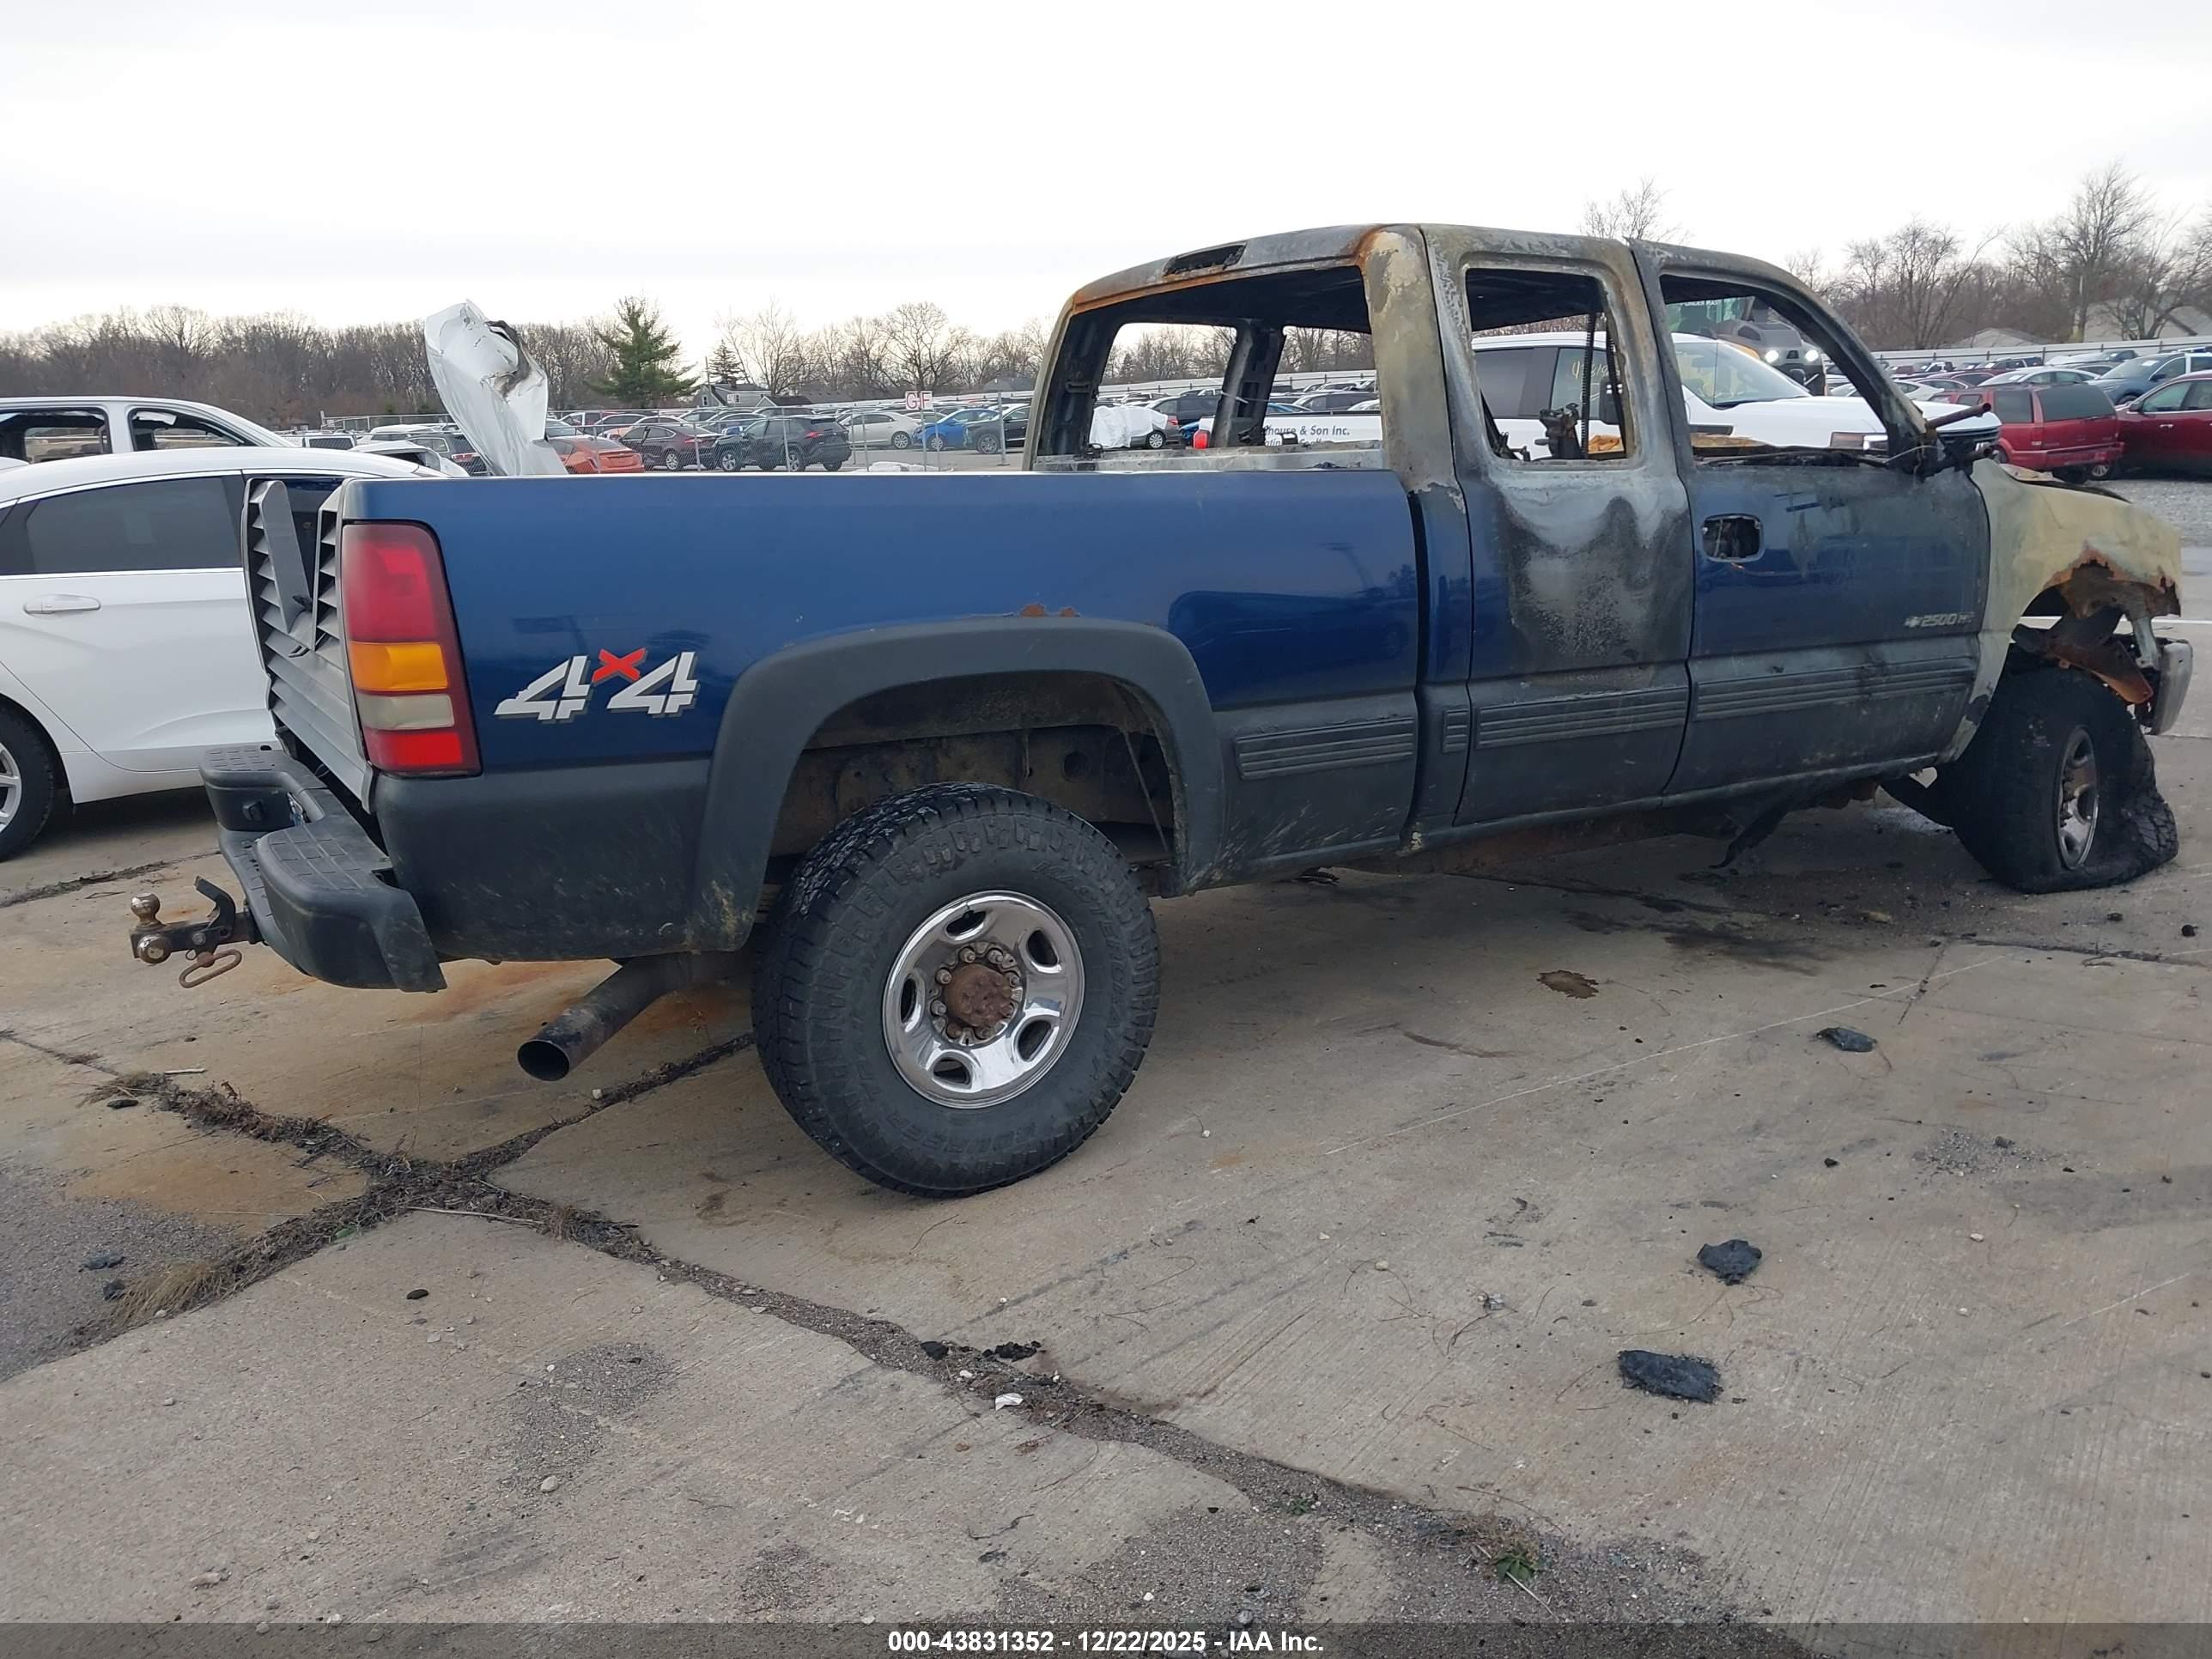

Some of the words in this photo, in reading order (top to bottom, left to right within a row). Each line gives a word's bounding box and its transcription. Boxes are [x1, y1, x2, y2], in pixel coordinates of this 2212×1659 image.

[1299, 425, 1307, 435] &
[1310, 425, 1328, 435] Son
[1332, 425, 1350, 435] Inc.
[1921, 613, 1958, 627] 2500
